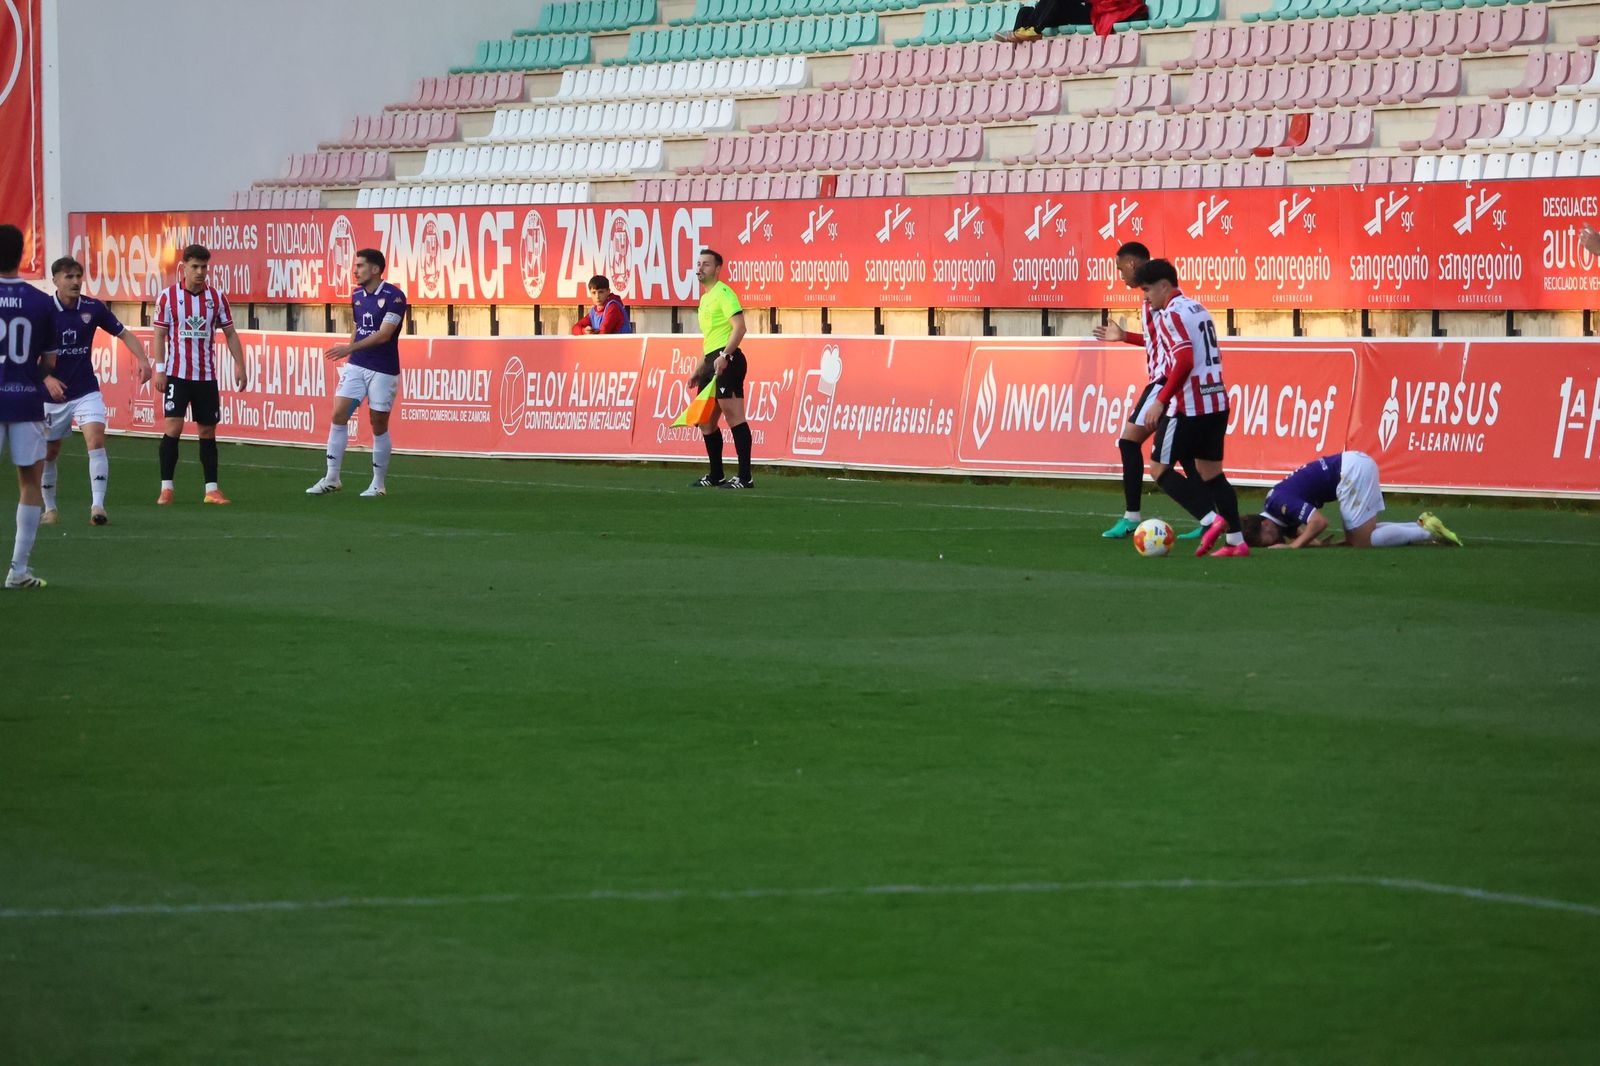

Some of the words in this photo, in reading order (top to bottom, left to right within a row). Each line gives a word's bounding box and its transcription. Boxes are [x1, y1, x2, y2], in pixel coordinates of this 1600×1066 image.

[1303, 213, 1316, 234] sgc
[1401, 209, 1414, 232] sgc
[1492, 210, 1507, 231] sgc
[1543, 196, 1598, 216] DESGUACES
[166, 217, 258, 250] www.cubiex.es
[266, 216, 324, 254] FUNDACIÓN
[764, 223, 773, 241] sgc
[828, 222, 838, 240] sgc
[905, 221, 915, 240] sgc
[973, 220, 984, 239] sgc
[1056, 218, 1066, 237] sgc
[1132, 216, 1143, 236] sgc
[1221, 215, 1232, 234] sgc
[374, 212, 475, 299] ZAMORA
[478, 211, 514, 300] CF
[557, 208, 670, 300] ZAMORA
[671, 208, 712, 300] CF
[728, 253, 784, 290] sangregorio
[790, 253, 849, 290] sangregorio
[865, 252, 926, 290] sangregorio
[933, 252, 995, 290] sangregorio
[1012, 250, 1079, 290] sangregorio
[1174, 248, 1246, 290] sangregorio
[1255, 248, 1330, 290] sangregorio
[1350, 247, 1429, 289] sangregorio
[1438, 246, 1522, 289] sangregorio
[213, 264, 230, 294] 630
[234, 264, 250, 295] 110
[1544, 277, 1577, 290] RECICLADO
[1580, 277, 1588, 290] DE
[1198, 320, 1220, 366] 19
[246, 344, 262, 392] DE
[265, 344, 282, 394] LA
[286, 346, 326, 397] PLATA
[402, 368, 492, 402] VALDERADUEY
[526, 371, 567, 407] ELOY
[569, 362, 638, 407] ÁLVAREZ
[167, 384, 174, 399] 3
[1406, 382, 1501, 426] VERSUS
[236, 398, 259, 427] Vino
[263, 401, 315, 433] (Zamora)
[402, 409, 408, 420] EL
[409, 409, 429, 420] CENTRO
[430, 410, 459, 422] COMERCIAL
[460, 410, 467, 422] DE
[468, 411, 490, 422] ZAMORA
[525, 411, 587, 429] CONTRUCCIONES
[589, 408, 632, 430] METÁLICAS
[799, 394, 830, 433] Susi
[833, 398, 954, 440] casqueriasusi.es
[1000, 384, 1073, 432] INNOVA
[1079, 384, 1136, 448] Chef
[1275, 385, 1337, 452] Chef
[657, 423, 680, 444] QUESO
[681, 427, 689, 441] DE
[1408, 432, 1484, 453] E-LEARNING
